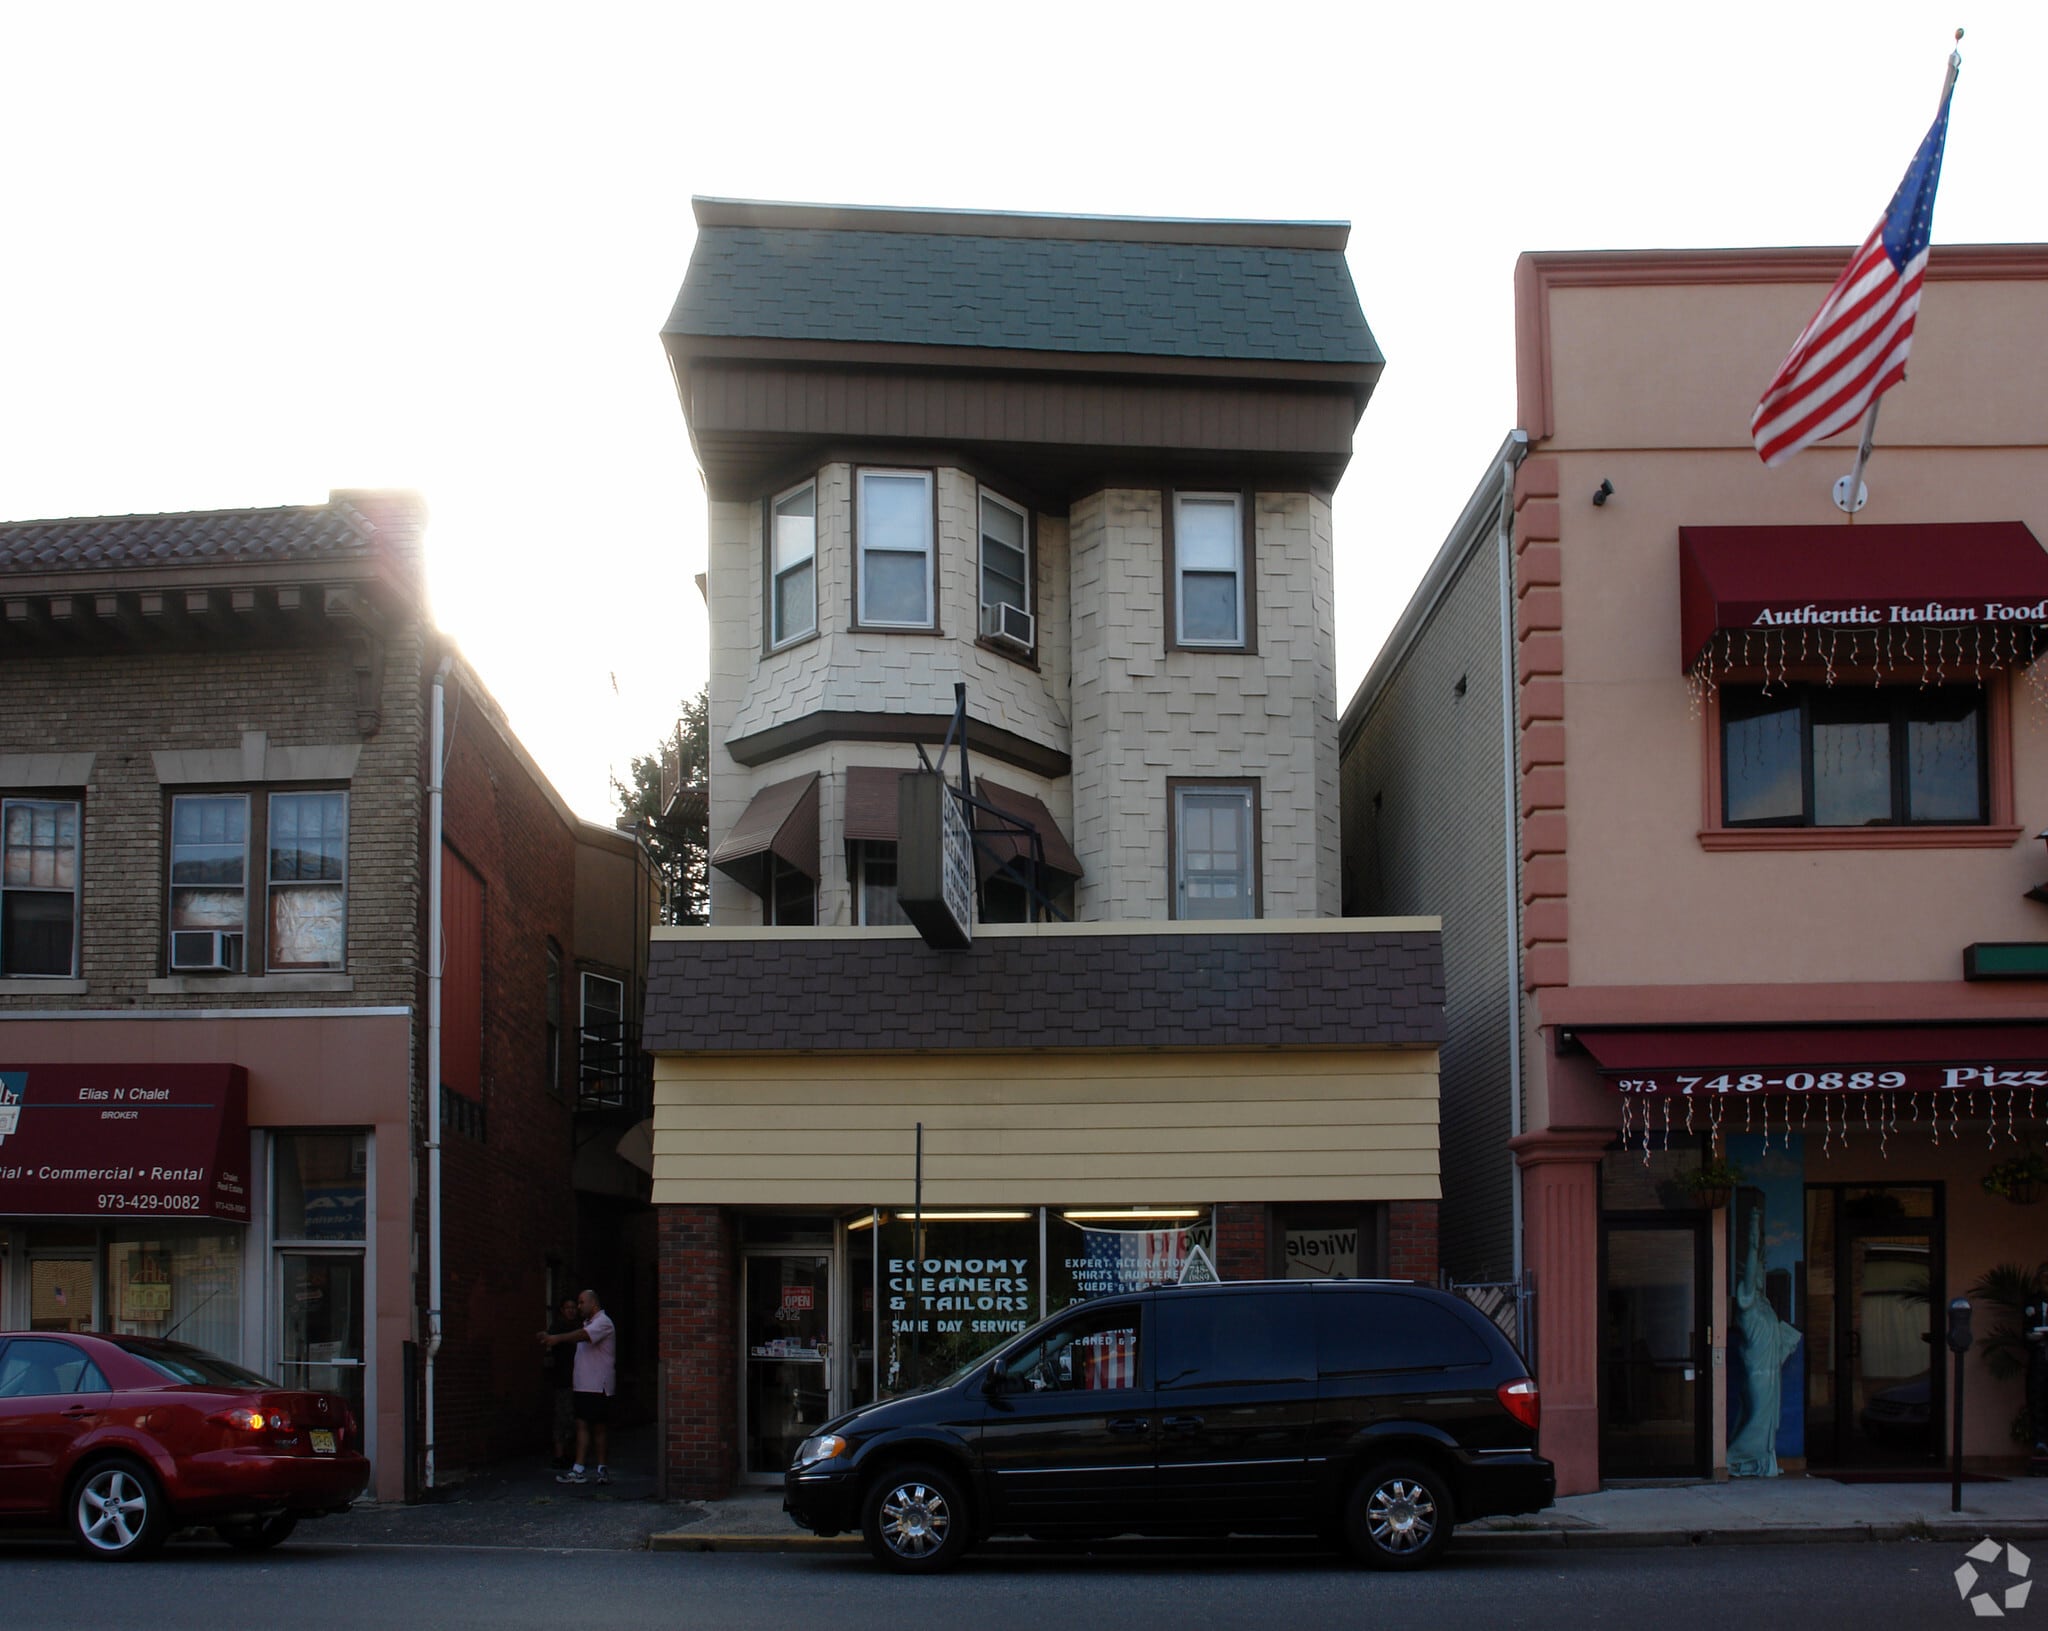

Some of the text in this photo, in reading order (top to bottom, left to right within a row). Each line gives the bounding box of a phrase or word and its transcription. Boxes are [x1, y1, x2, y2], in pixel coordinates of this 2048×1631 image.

[1752, 600, 2048, 626] Authentic Italian Food
[1619, 1080, 1657, 1093] 973
[1676, 1071, 1906, 1095] 748-0889
[79, 1087, 170, 1100] Elias N Chalet
[101, 1111, 139, 1120] BROKER
[38, 1166, 134, 1180] Commercial
[150, 1167, 204, 1181] Rental
[97, 1194, 200, 1210] 973-429-0082
[888, 1258, 1028, 1274] ECONOMY
[1064, 1258, 1110, 1268] EXPERT
[1071, 1270, 1180, 1280] SHIRTS LAUNDERE
[889, 1277, 1029, 1293] CLEANERS
[1077, 1282, 1114, 1291] SUEDE
[785, 1295, 811, 1307] OPEN
[889, 1296, 1029, 1312] & TAILORS
[774, 1305, 801, 1321] 412
[937, 1320, 963, 1332] DAY
[971, 1320, 1027, 1333] SERVICE
